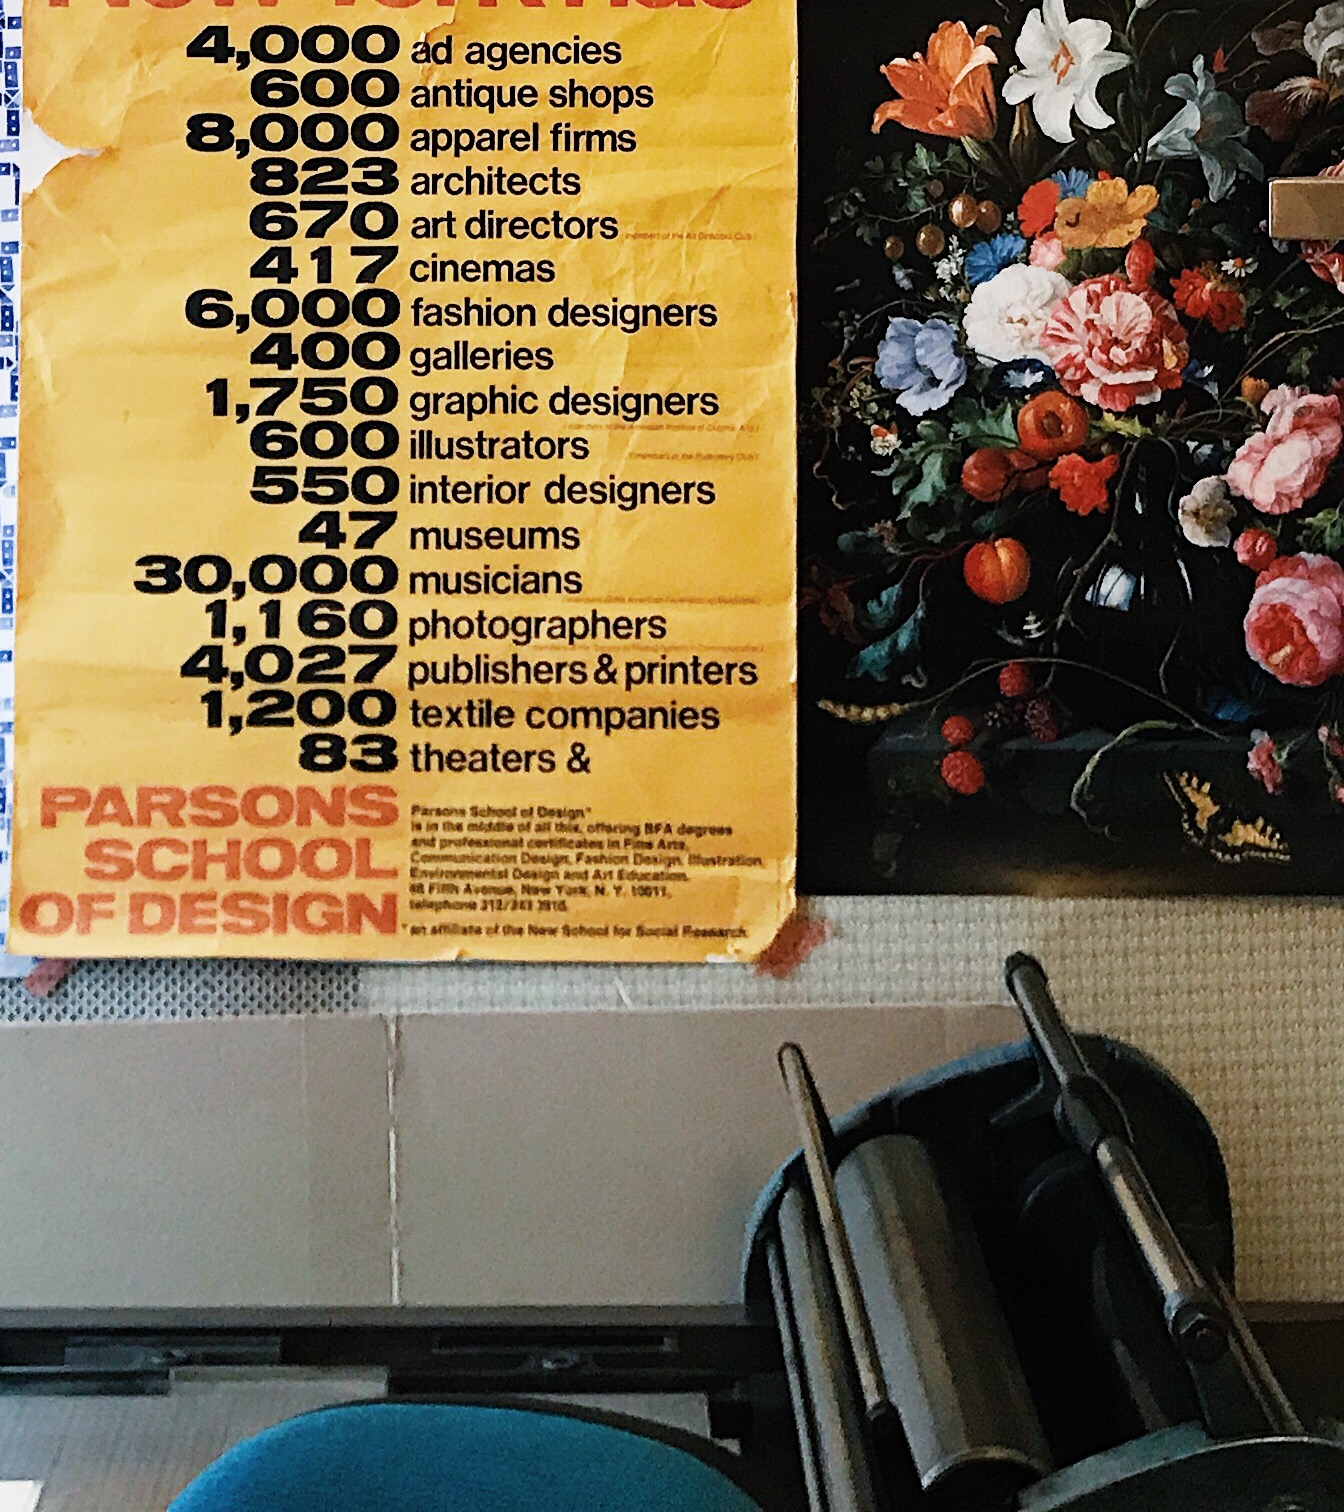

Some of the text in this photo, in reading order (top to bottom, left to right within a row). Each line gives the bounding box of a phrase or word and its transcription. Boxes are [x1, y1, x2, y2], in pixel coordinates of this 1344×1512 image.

[187, 25, 621, 71] 4,000 ad agencies
[250, 68, 653, 114] 600 antique shops
[186, 113, 636, 160] 8,000 apparel firms
[250, 157, 581, 196] 823 architects
[250, 201, 618, 240] 670 art directors
[250, 246, 555, 284] 417 cinemas
[185, 288, 717, 335] 6,000 fashion designers
[250, 331, 553, 376] 400 galleries
[206, 376, 719, 423] 1,750 graphic designers
[250, 420, 589, 459] 600 illustrators
[250, 466, 715, 511] 550 interior designers
[299, 511, 580, 550] 47 museums
[134, 554, 582, 602] 30,000 musicians
[202, 598, 666, 647] 1,160 photographers
[180, 643, 758, 692] 4,027 publishers & printers
[201, 688, 719, 737] 1,200 textile companies
[299, 733, 590, 773] 83 theaters &
[41, 784, 399, 828] PARSONS
[85, 837, 398, 881] SCHOOL
[18, 892, 398, 935] OF DESIGN
